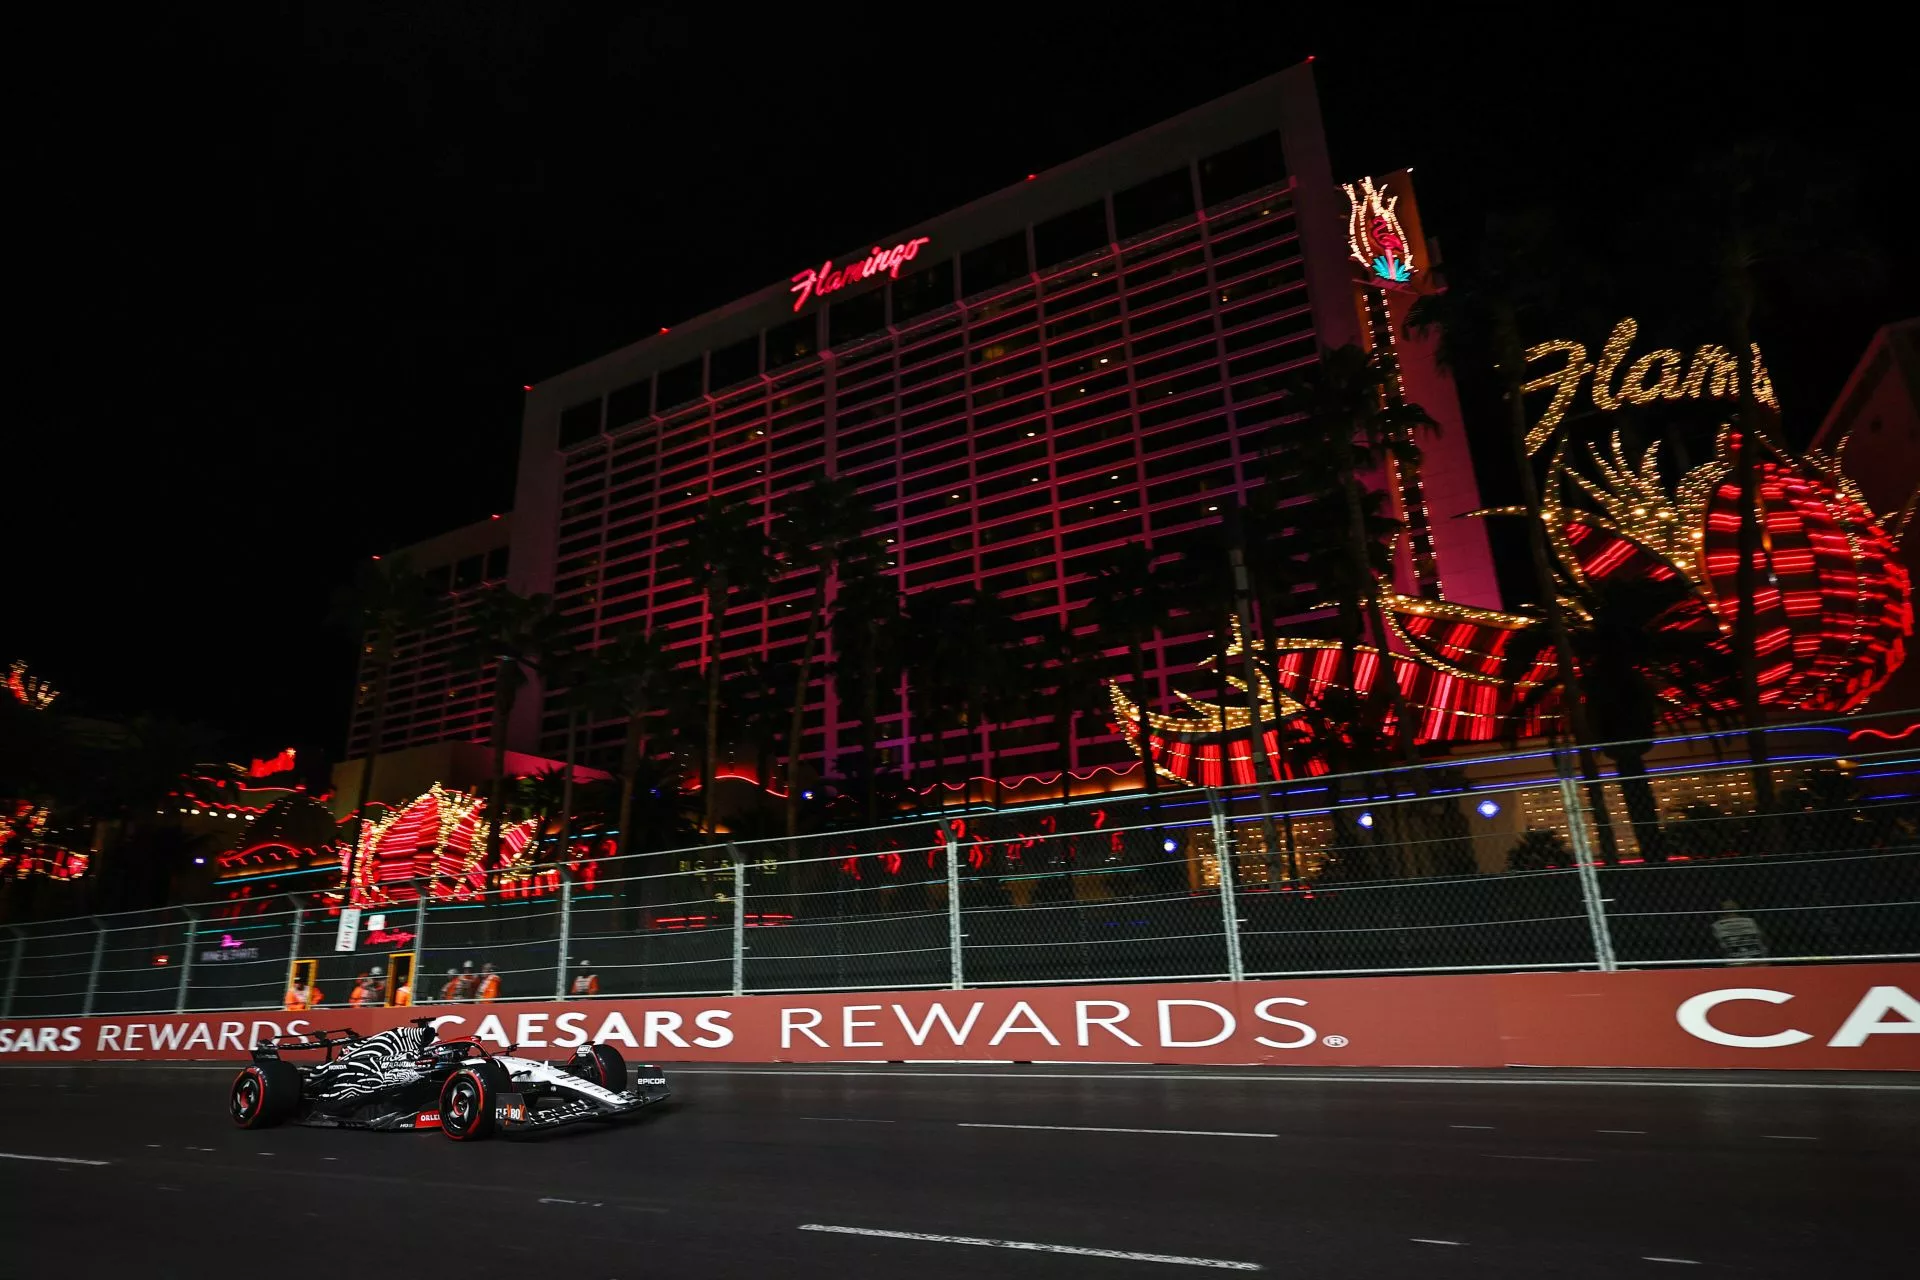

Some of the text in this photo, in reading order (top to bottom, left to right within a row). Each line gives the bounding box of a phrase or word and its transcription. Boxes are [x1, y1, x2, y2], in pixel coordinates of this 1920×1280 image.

[789, 236, 932, 312] Flamingo
[0, 1019, 310, 1053] SARS REWARDS
[431, 1009, 735, 1049] CAESARS
[1676, 986, 1920, 1049] CA
